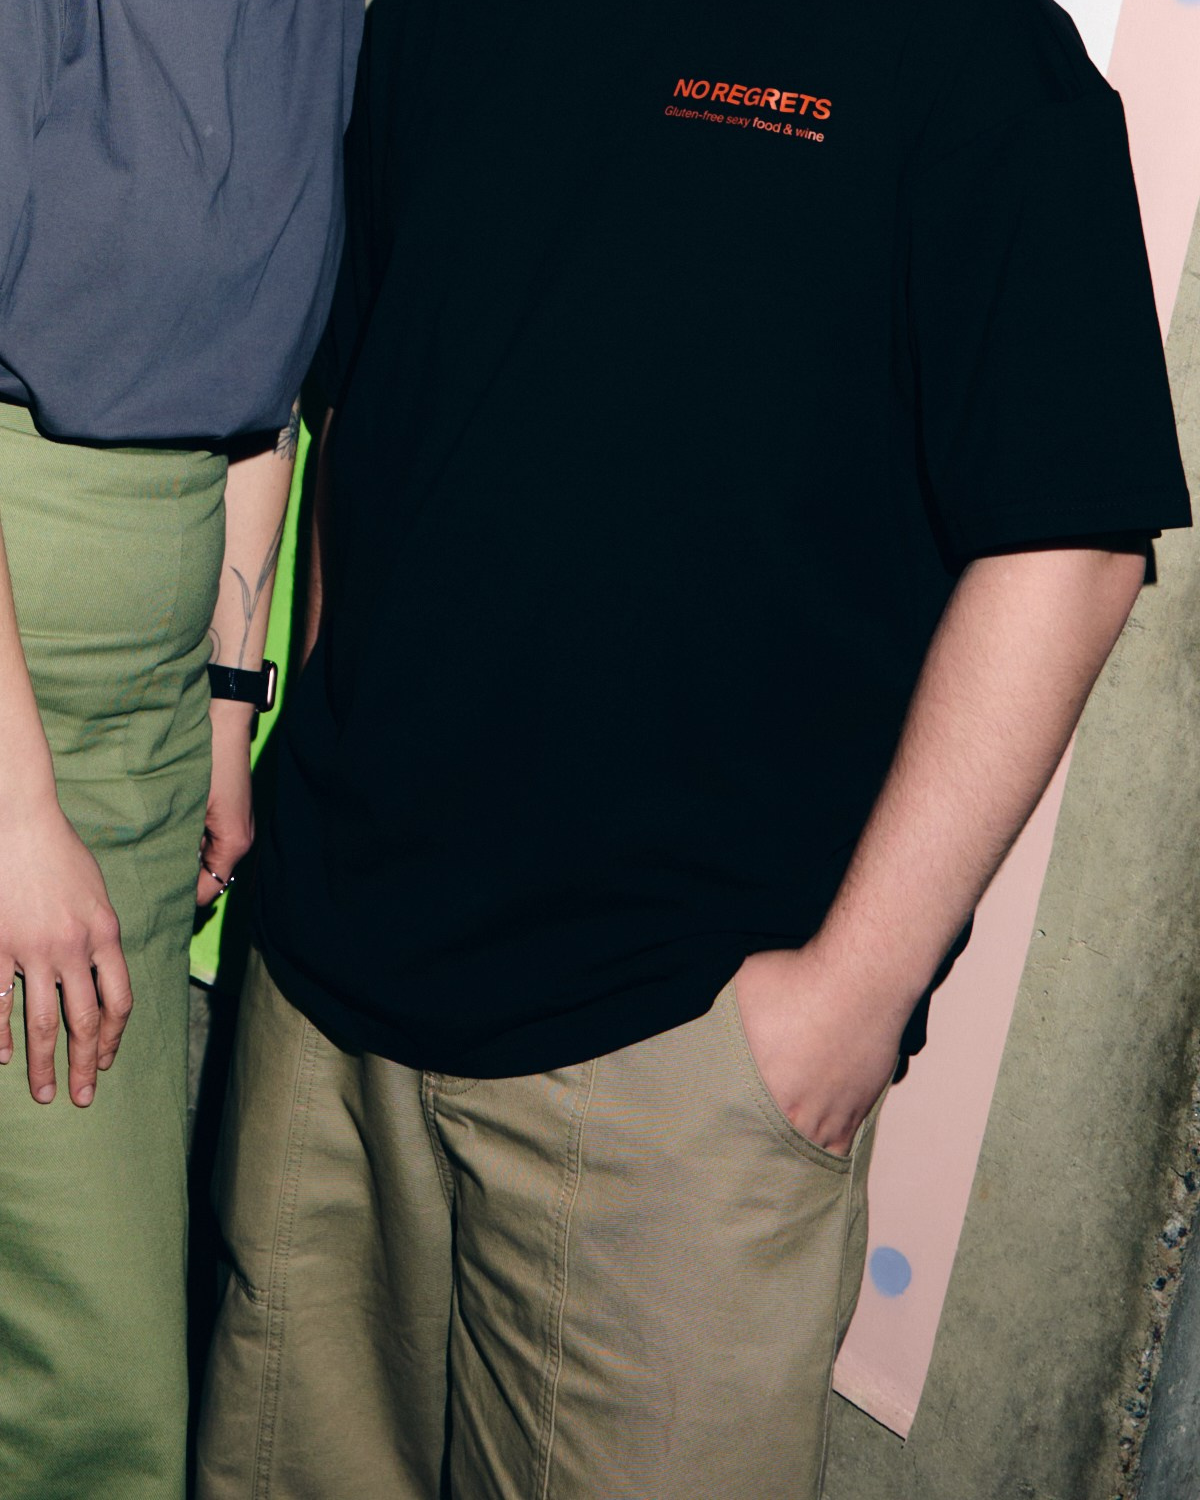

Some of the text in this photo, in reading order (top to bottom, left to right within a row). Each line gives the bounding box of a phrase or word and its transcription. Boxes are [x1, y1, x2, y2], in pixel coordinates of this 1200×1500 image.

[664, 105, 825, 143] Gluten-free sexy food & wine
